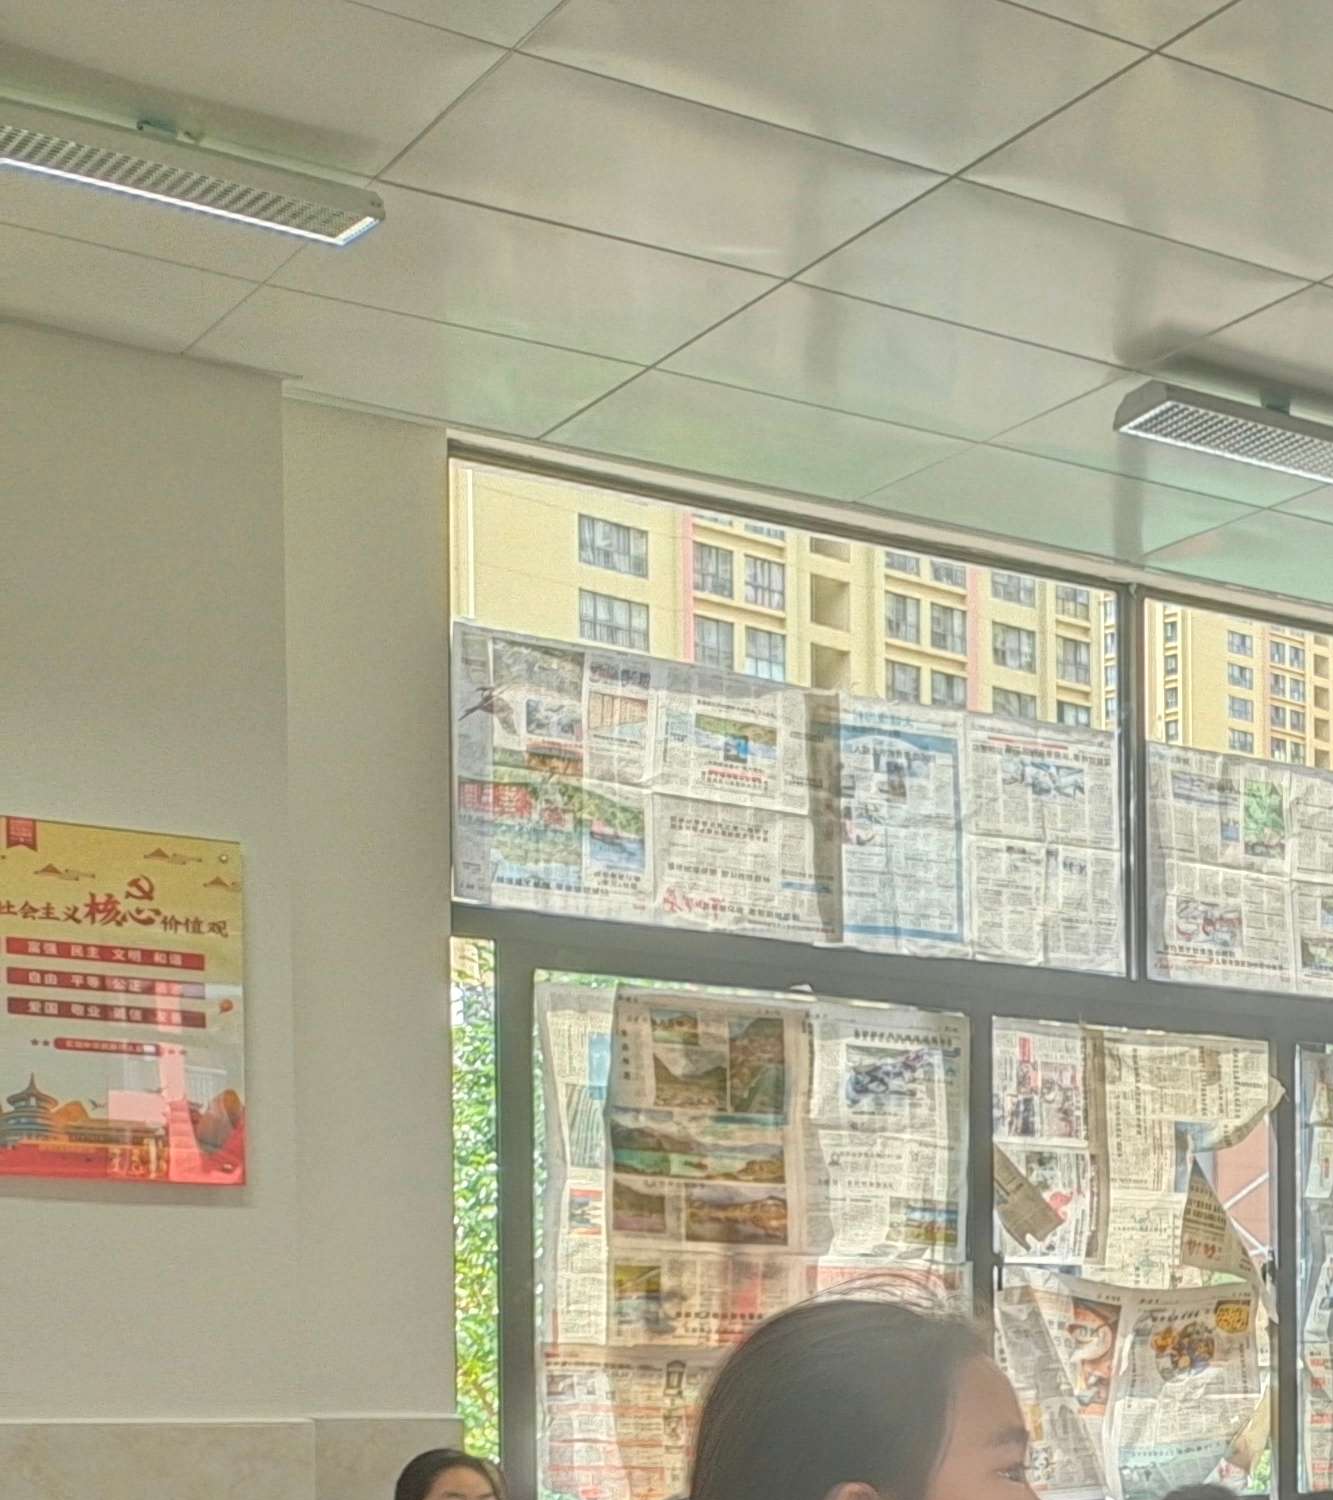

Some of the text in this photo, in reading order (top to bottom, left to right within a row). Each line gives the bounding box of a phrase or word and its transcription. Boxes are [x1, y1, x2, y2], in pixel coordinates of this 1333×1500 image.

[71, 945, 100, 959] 民主
[112, 948, 142, 962] 文明
[153, 952, 182, 966] 和谐
[28, 971, 58, 985] 自由
[71, 974, 100, 988] 平等
[112, 977, 142, 992] 公正
